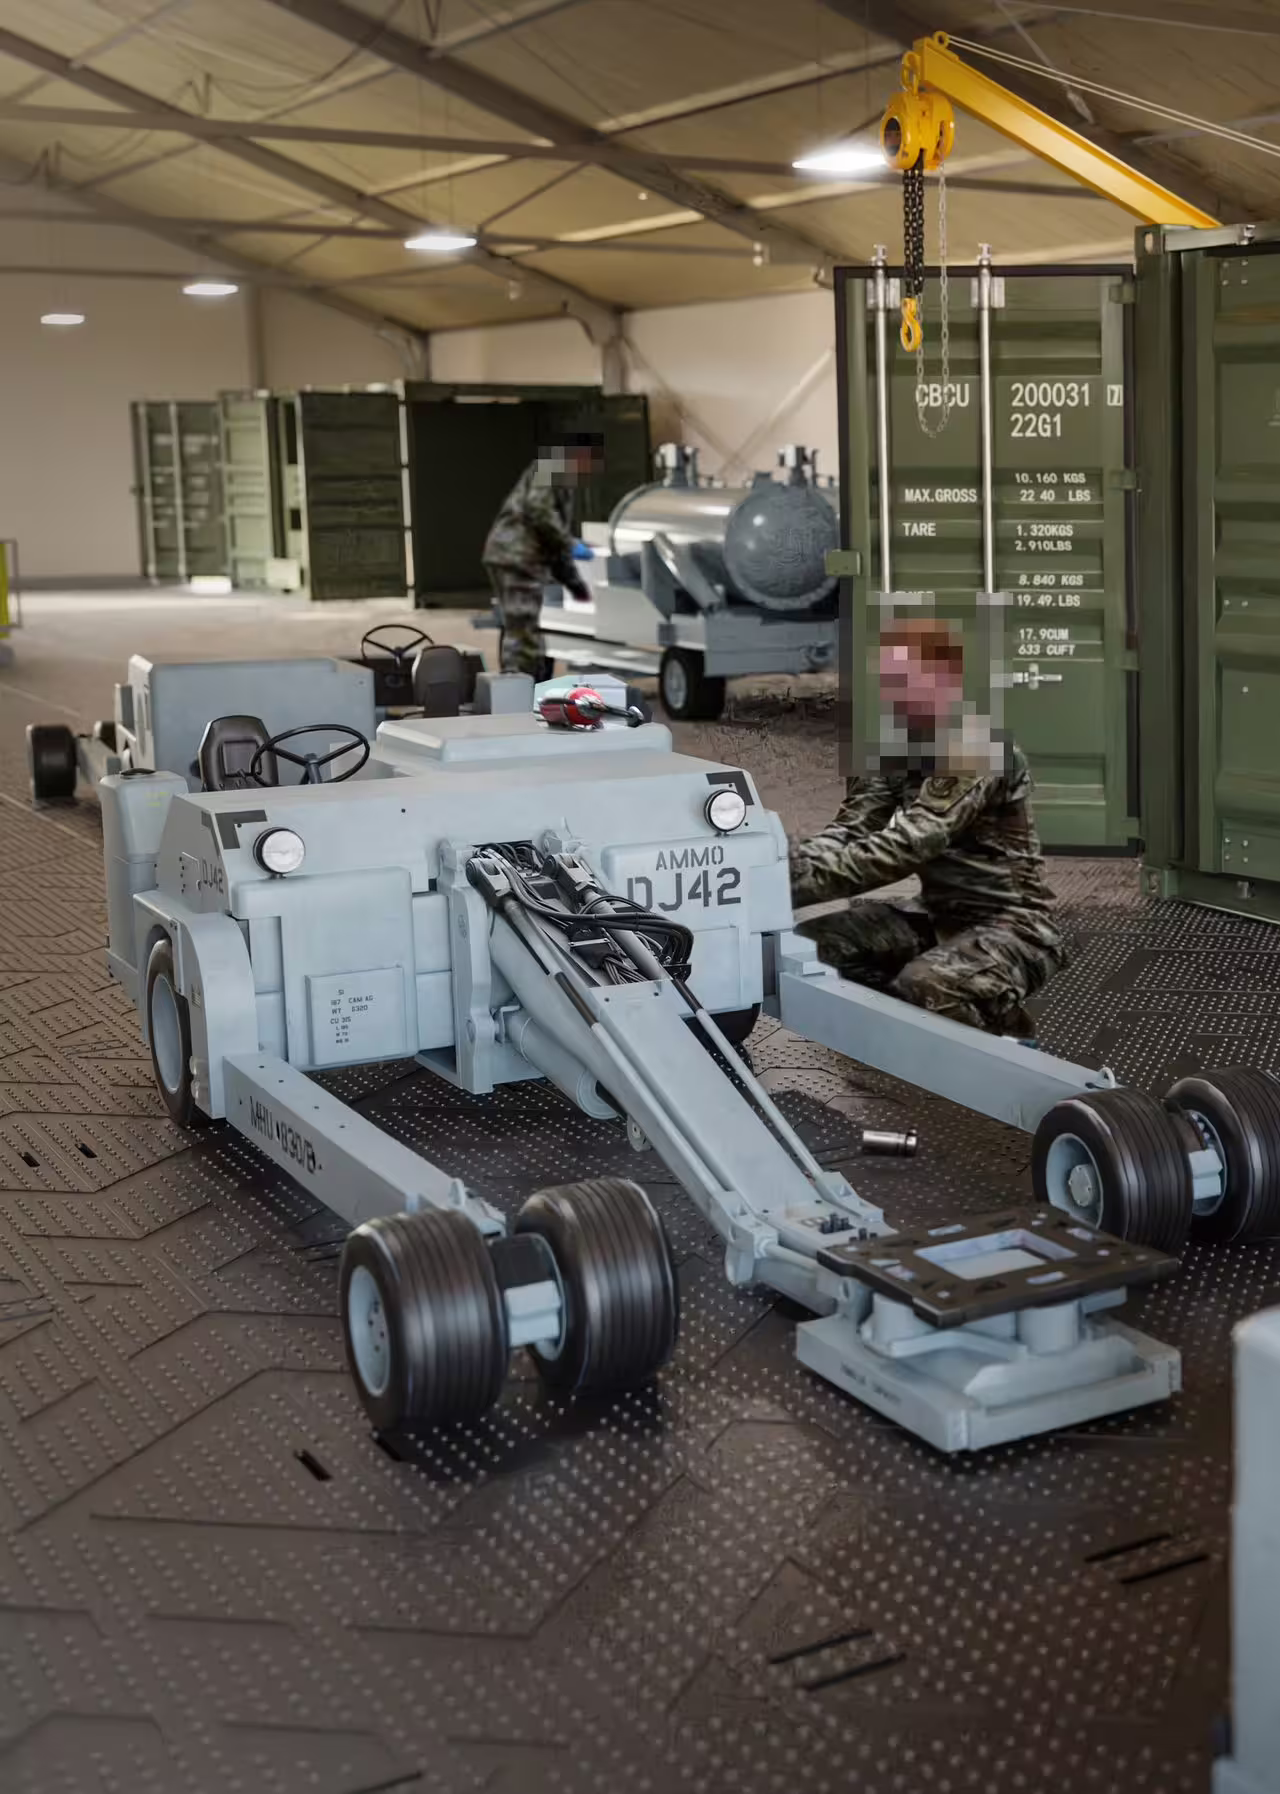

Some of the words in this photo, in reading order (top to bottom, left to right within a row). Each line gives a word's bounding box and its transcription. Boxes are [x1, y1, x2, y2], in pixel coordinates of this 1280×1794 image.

[916, 383, 970, 407] CBCU
[1010, 382, 1090, 407] 200031
[1010, 413, 1062, 437] 22G1
[1015, 472, 1058, 484] 10.160
[1063, 472, 1087, 484] KGS
[904, 488, 978, 503] MAX.GROSS
[1068, 489, 1091, 502] LBS
[902, 522, 937, 537] TARE
[1018, 574, 1056, 586] 8.840
[1061, 574, 1084, 586] KGS
[1018, 643, 1041, 656] 633
[1046, 643, 1076, 656] CUFT
[655, 845, 725, 871] AMMO
[625, 867, 742, 913] DJ42
